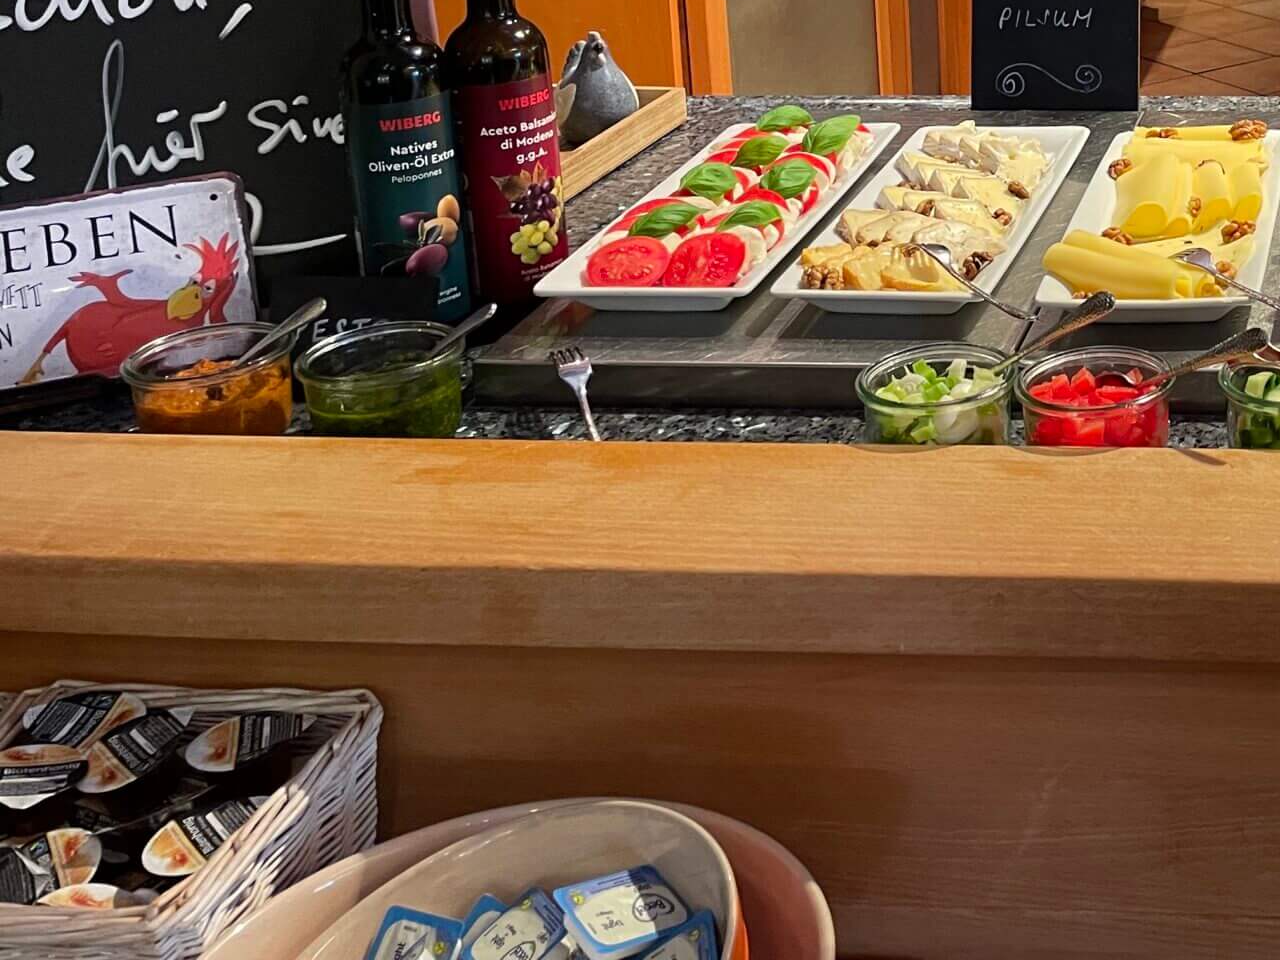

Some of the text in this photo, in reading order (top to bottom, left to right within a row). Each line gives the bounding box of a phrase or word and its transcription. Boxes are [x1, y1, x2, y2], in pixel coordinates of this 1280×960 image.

[998, 6, 1093, 29] PILSUM
[499, 88, 550, 111] WIBERG
[85, 39, 228, 192] hier
[380, 111, 441, 132] WIBERG
[480, 125, 517, 137] Aceto
[500, 129, 554, 150] di Modena
[390, 140, 438, 156] Natives
[516, 147, 548, 164] g.g.A.
[368, 148, 455, 172] Oliven-Öl Extra
[391, 168, 443, 184] Peloponnes
